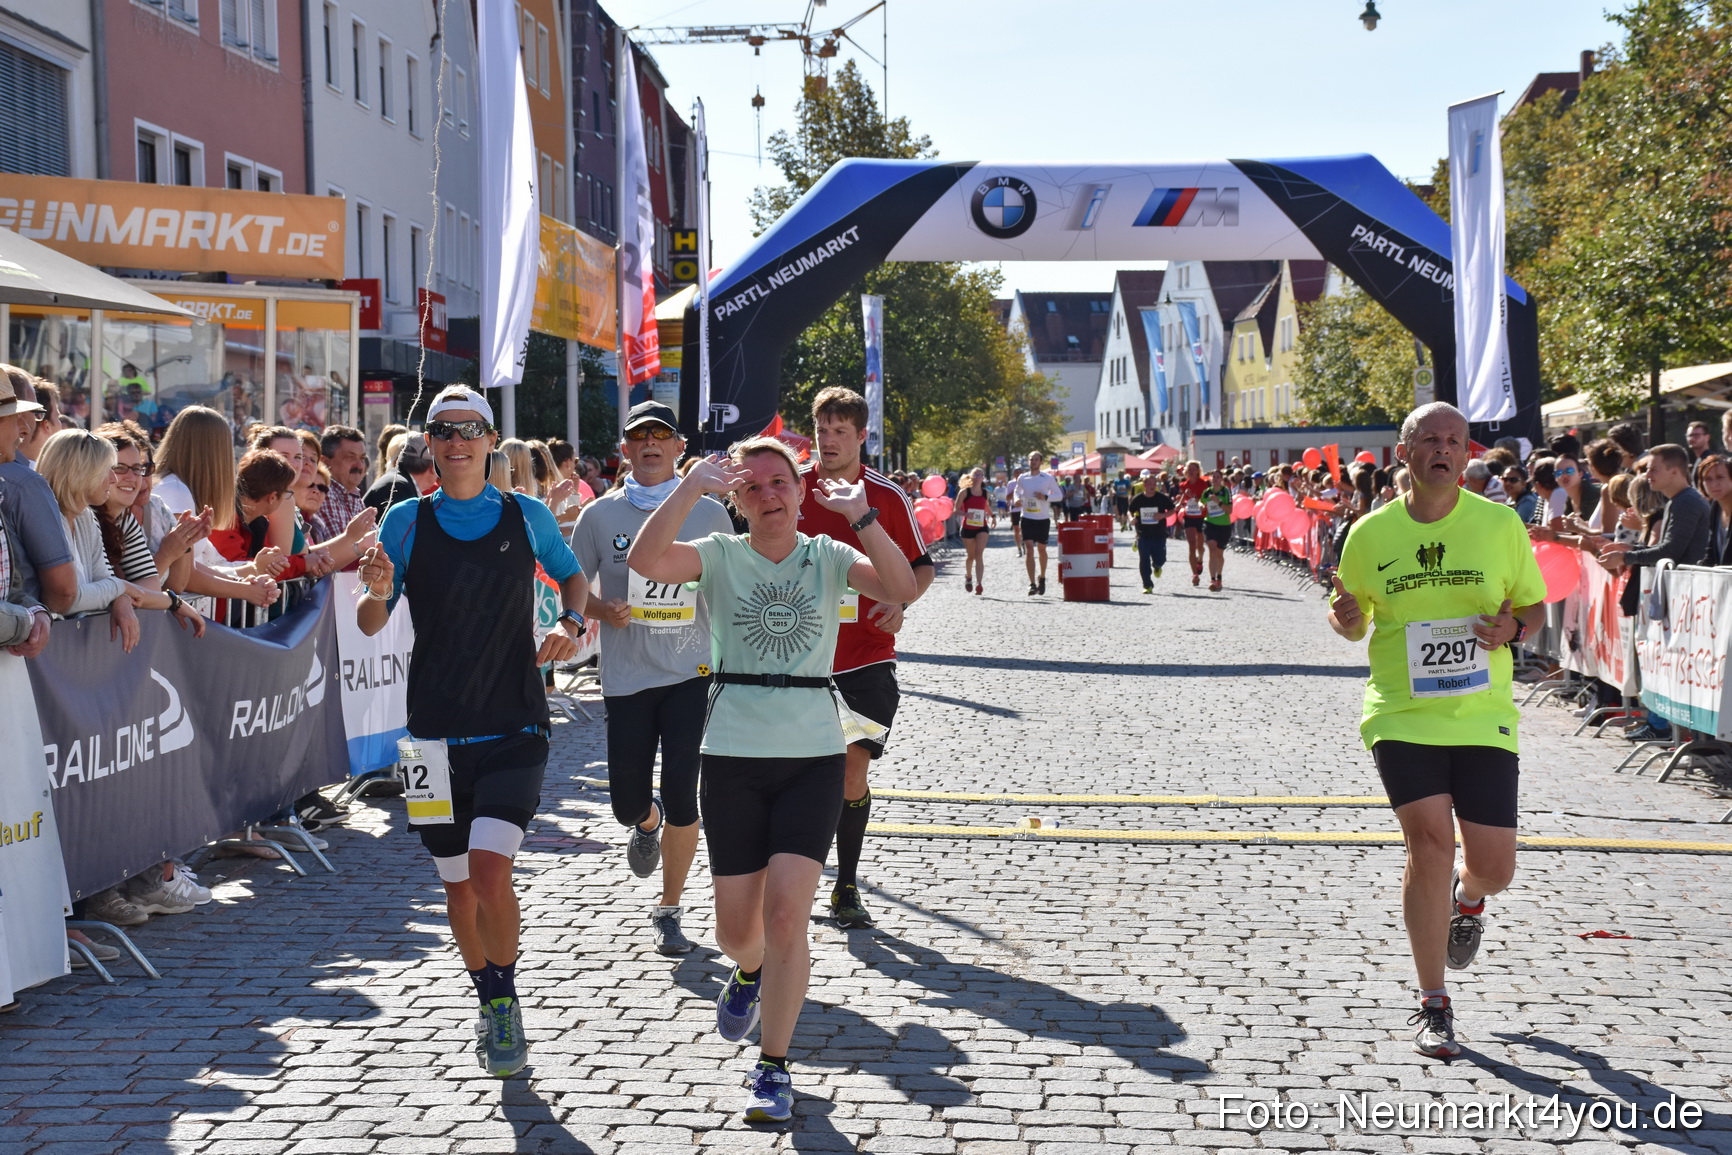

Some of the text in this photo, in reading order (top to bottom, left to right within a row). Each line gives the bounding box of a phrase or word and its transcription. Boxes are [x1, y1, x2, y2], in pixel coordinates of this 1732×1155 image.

[1351, 224, 1455, 292] PARTL NEUM
[714, 225, 861, 322] PARTL NEUMARKT
[643, 610, 682, 620] Wolfgang
[649, 627, 682, 635] Stadtlauf
[1431, 625, 1468, 637] BOCK
[1421, 637, 1478, 667] 2297
[1438, 676, 1471, 689] Robert
[398, 748, 423, 759] OCK
